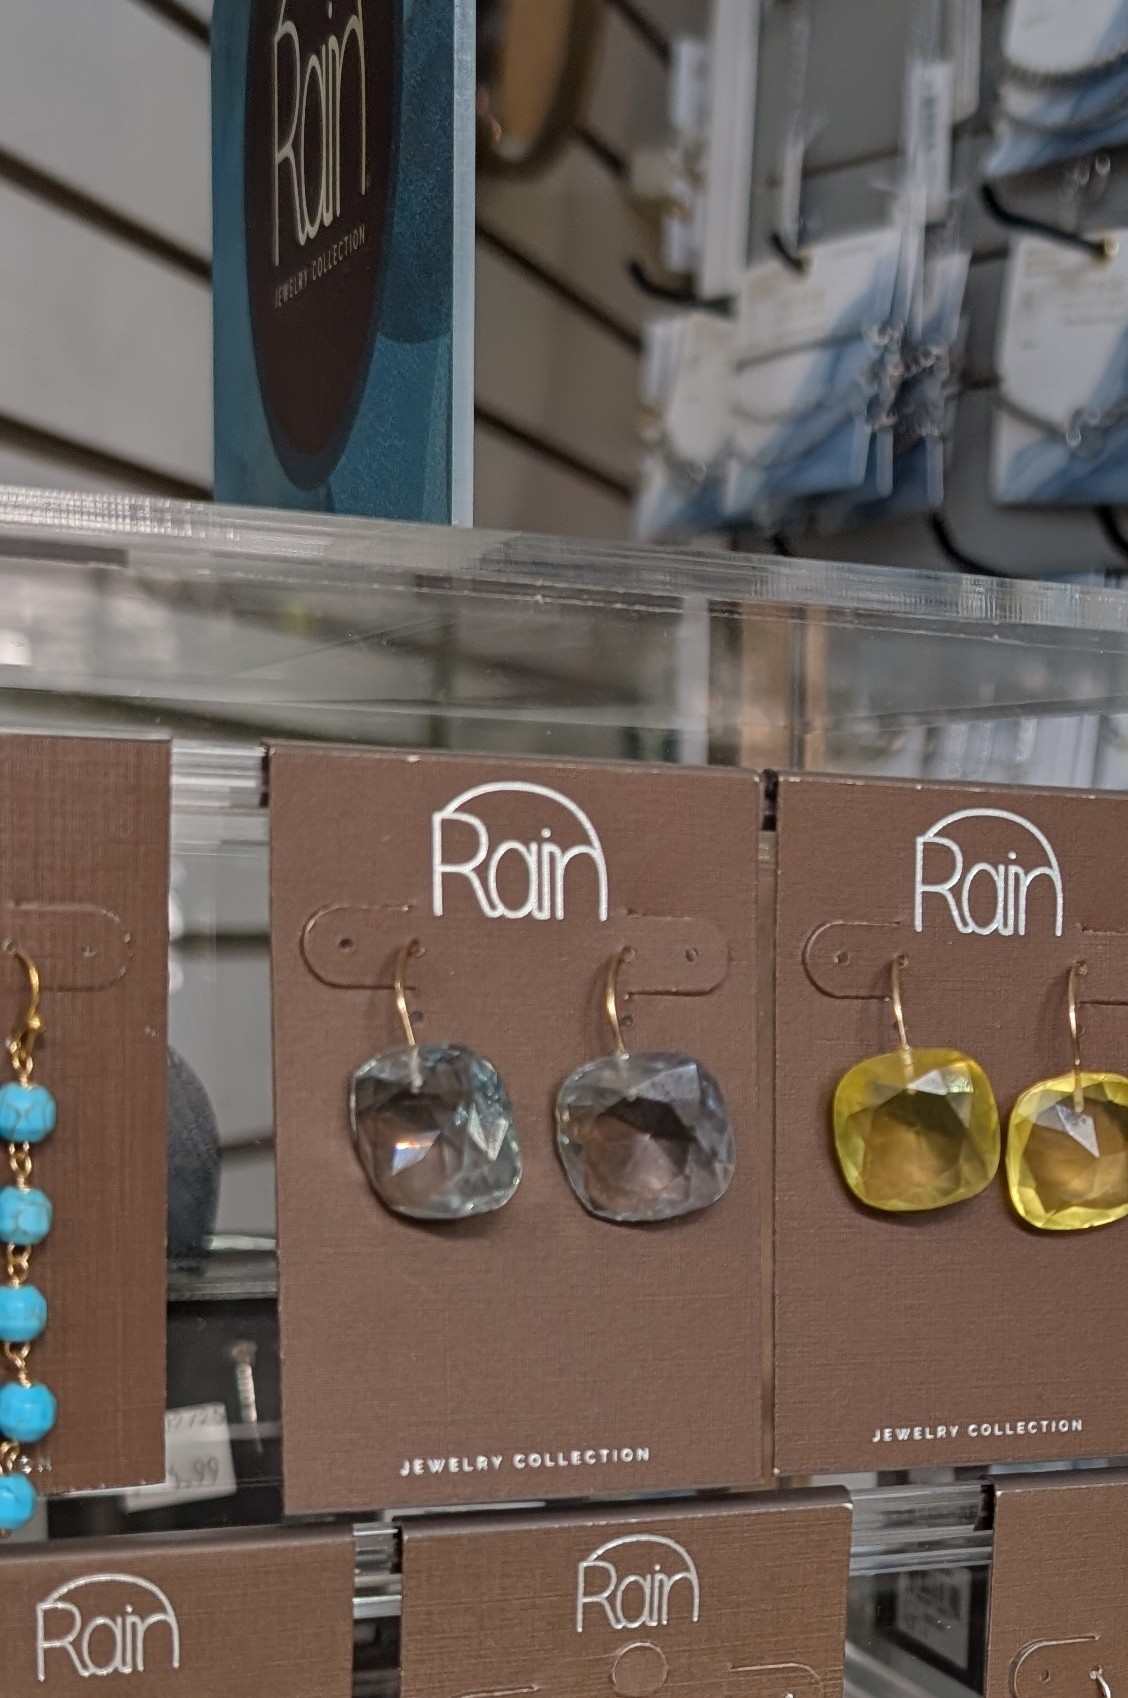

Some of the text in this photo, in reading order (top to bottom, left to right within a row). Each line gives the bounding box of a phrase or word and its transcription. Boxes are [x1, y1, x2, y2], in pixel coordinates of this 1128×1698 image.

[274, 0, 366, 267] Rain
[275, 222, 365, 310] JEWELRY COLLECTION
[432, 781, 608, 921] Rain
[914, 807, 1063, 937] Rain
[400, 1447, 650, 1476] JEWELRY COLLECTION
[872, 1418, 1083, 1443] JEWELRY COLLECTION
[36, 1573, 180, 1682] Rain
[576, 1533, 700, 1633] Rain
